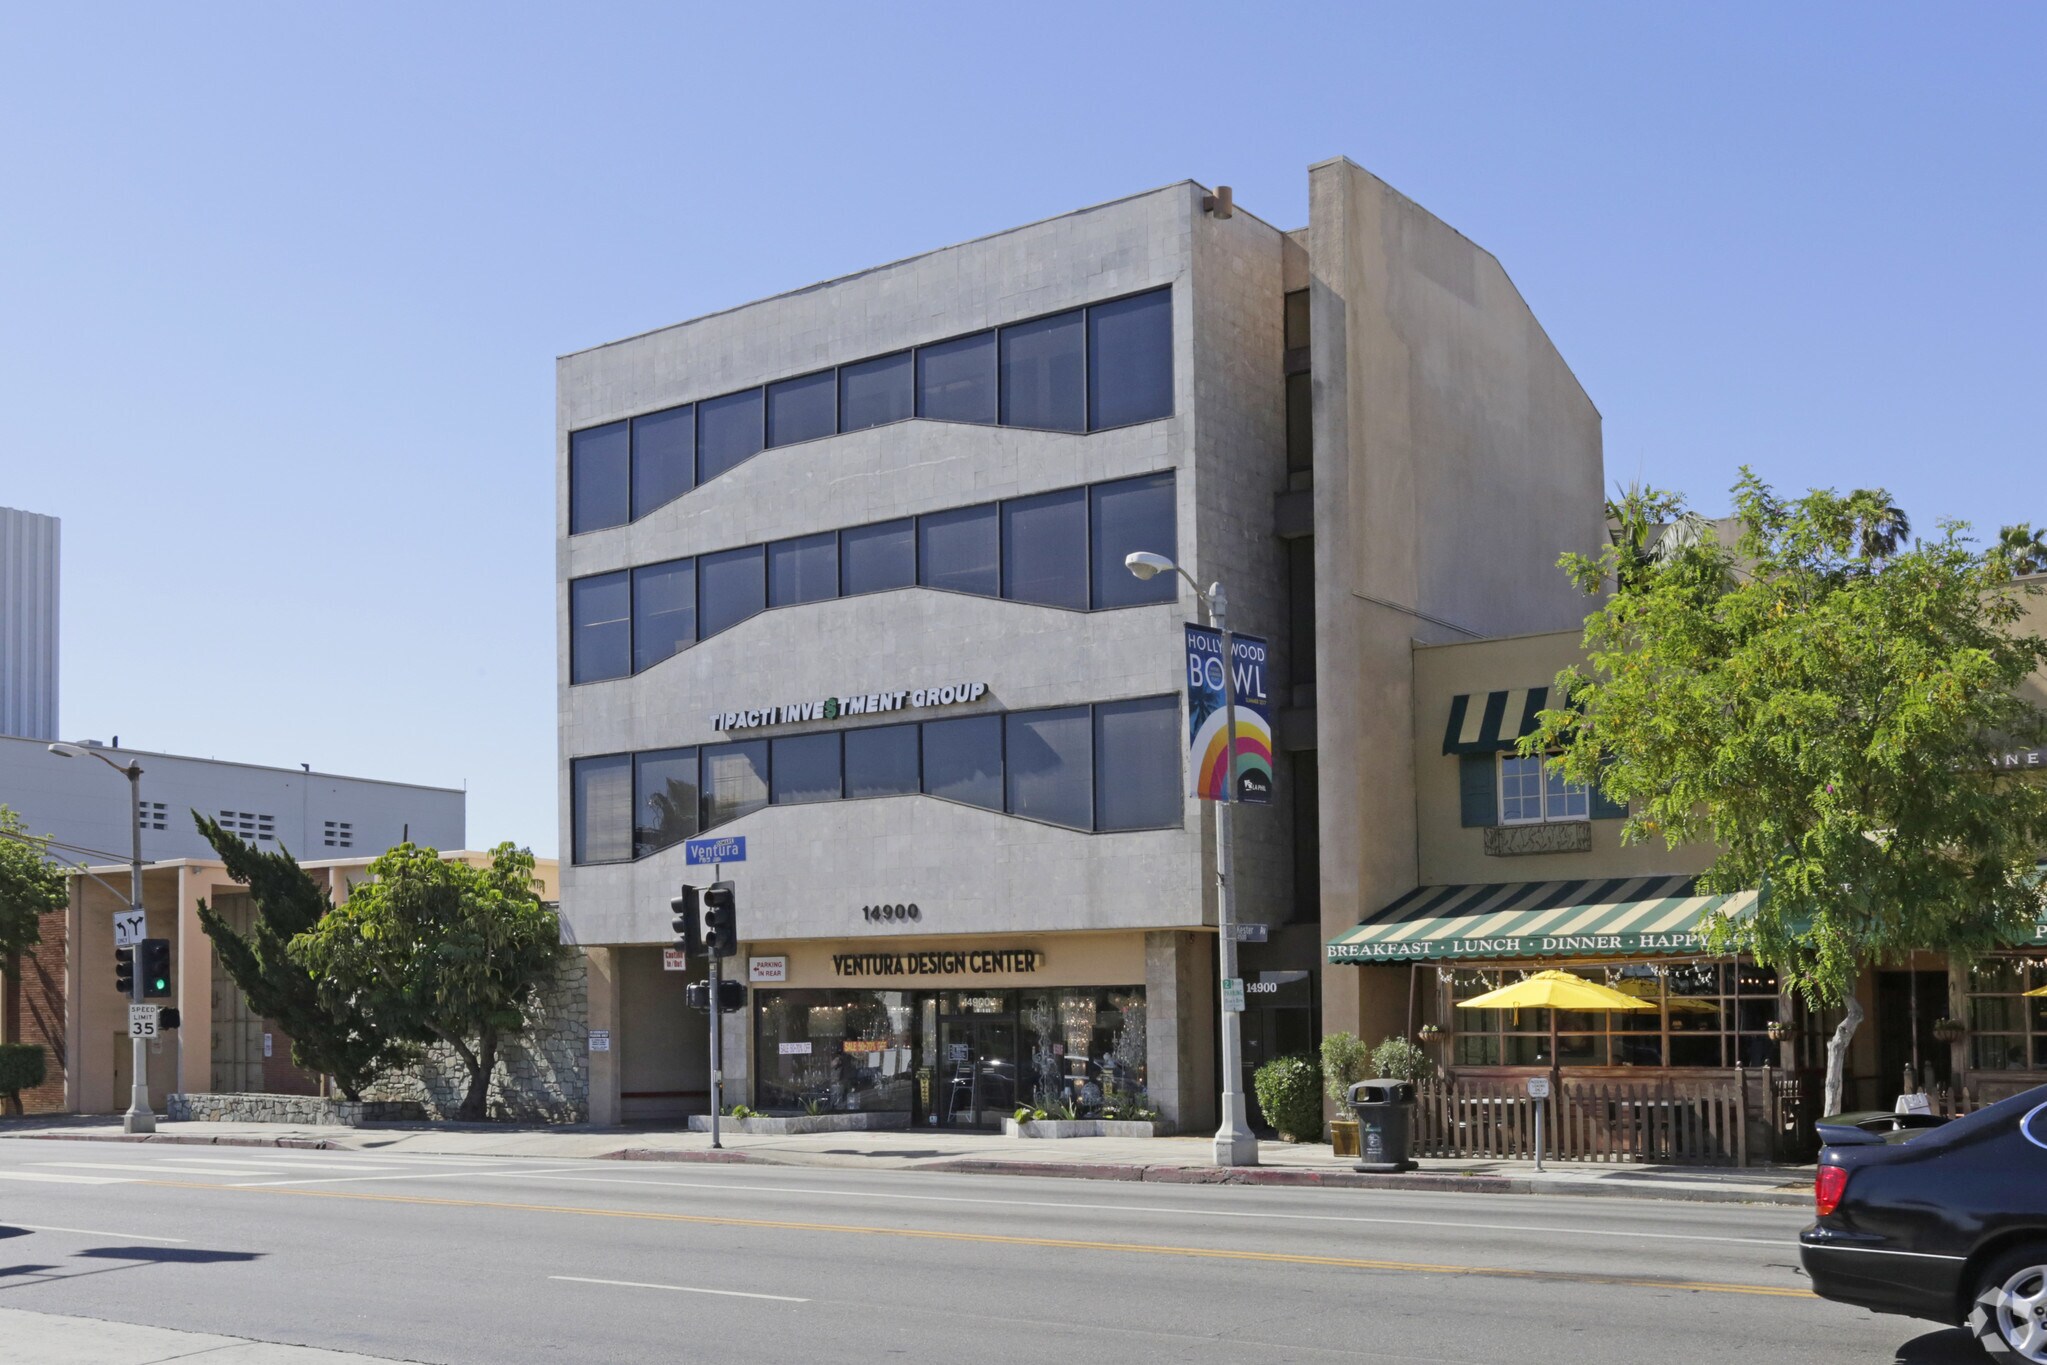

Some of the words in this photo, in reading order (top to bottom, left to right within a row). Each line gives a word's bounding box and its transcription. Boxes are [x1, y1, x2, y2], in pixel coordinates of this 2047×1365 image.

[1189, 653, 1267, 698] BOWL
[709, 707, 779, 731] TIPACTI
[911, 683, 988, 708] GROUP
[691, 844, 739, 858] Ventura
[861, 903, 919, 921] 14900
[1326, 941, 1433, 957] BREAKFAST
[1453, 938, 1521, 953] LUNCH
[1542, 935, 1622, 950] DINNER
[1639, 933, 1709, 948] HAPPY
[832, 952, 904, 976] VENTURA
[907, 951, 966, 975] DESIGN
[969, 949, 1035, 973] CENTER
[1246, 982, 1277, 993] 14900
[132, 1022, 154, 1035] 35
